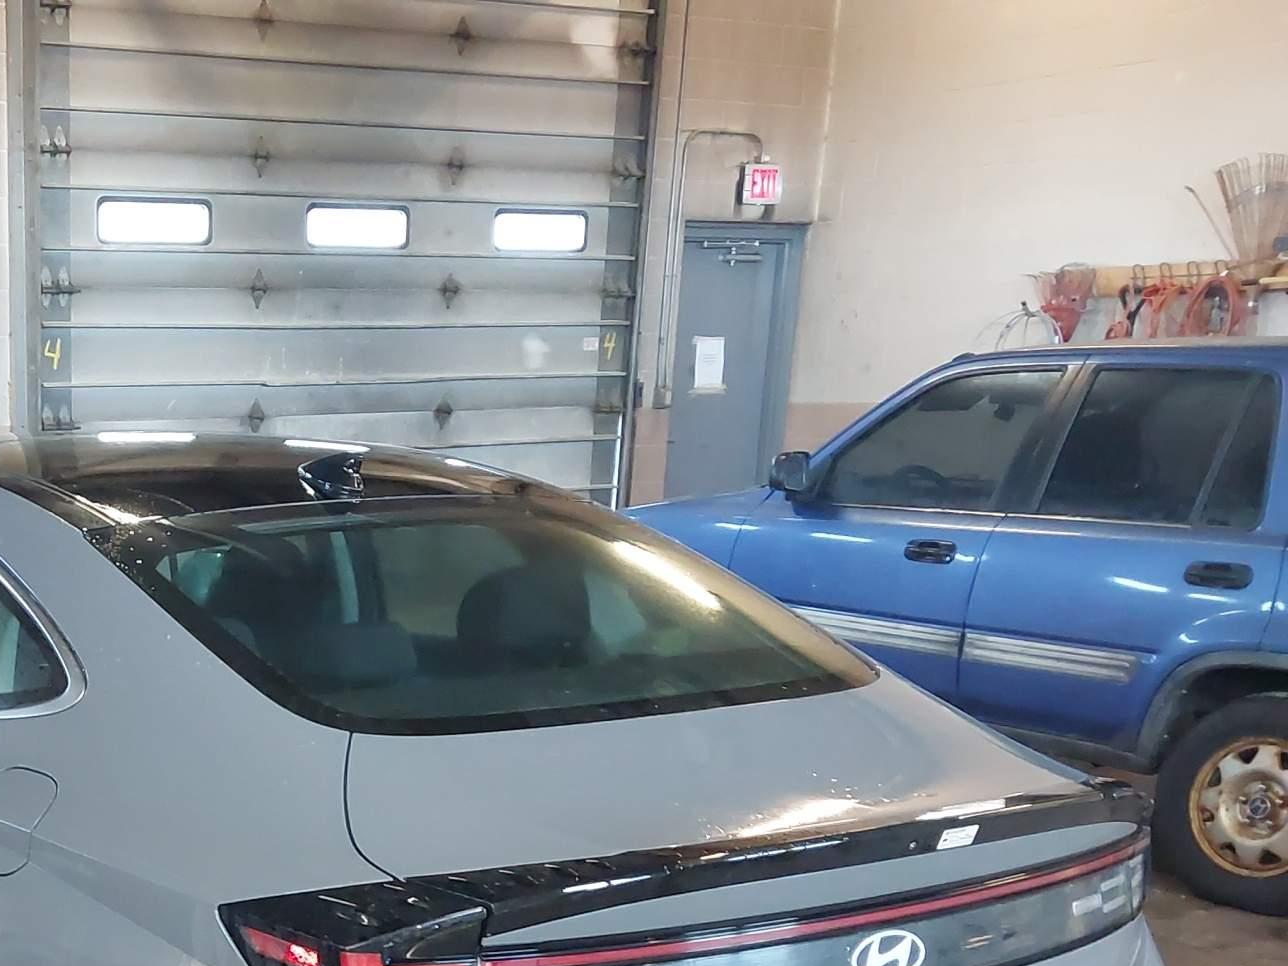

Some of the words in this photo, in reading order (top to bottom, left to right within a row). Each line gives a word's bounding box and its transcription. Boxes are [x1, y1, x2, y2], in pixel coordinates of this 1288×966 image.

[751, 168, 778, 199] EXIT
[44, 337, 61, 371] 4
[603, 332, 617, 361] 4
